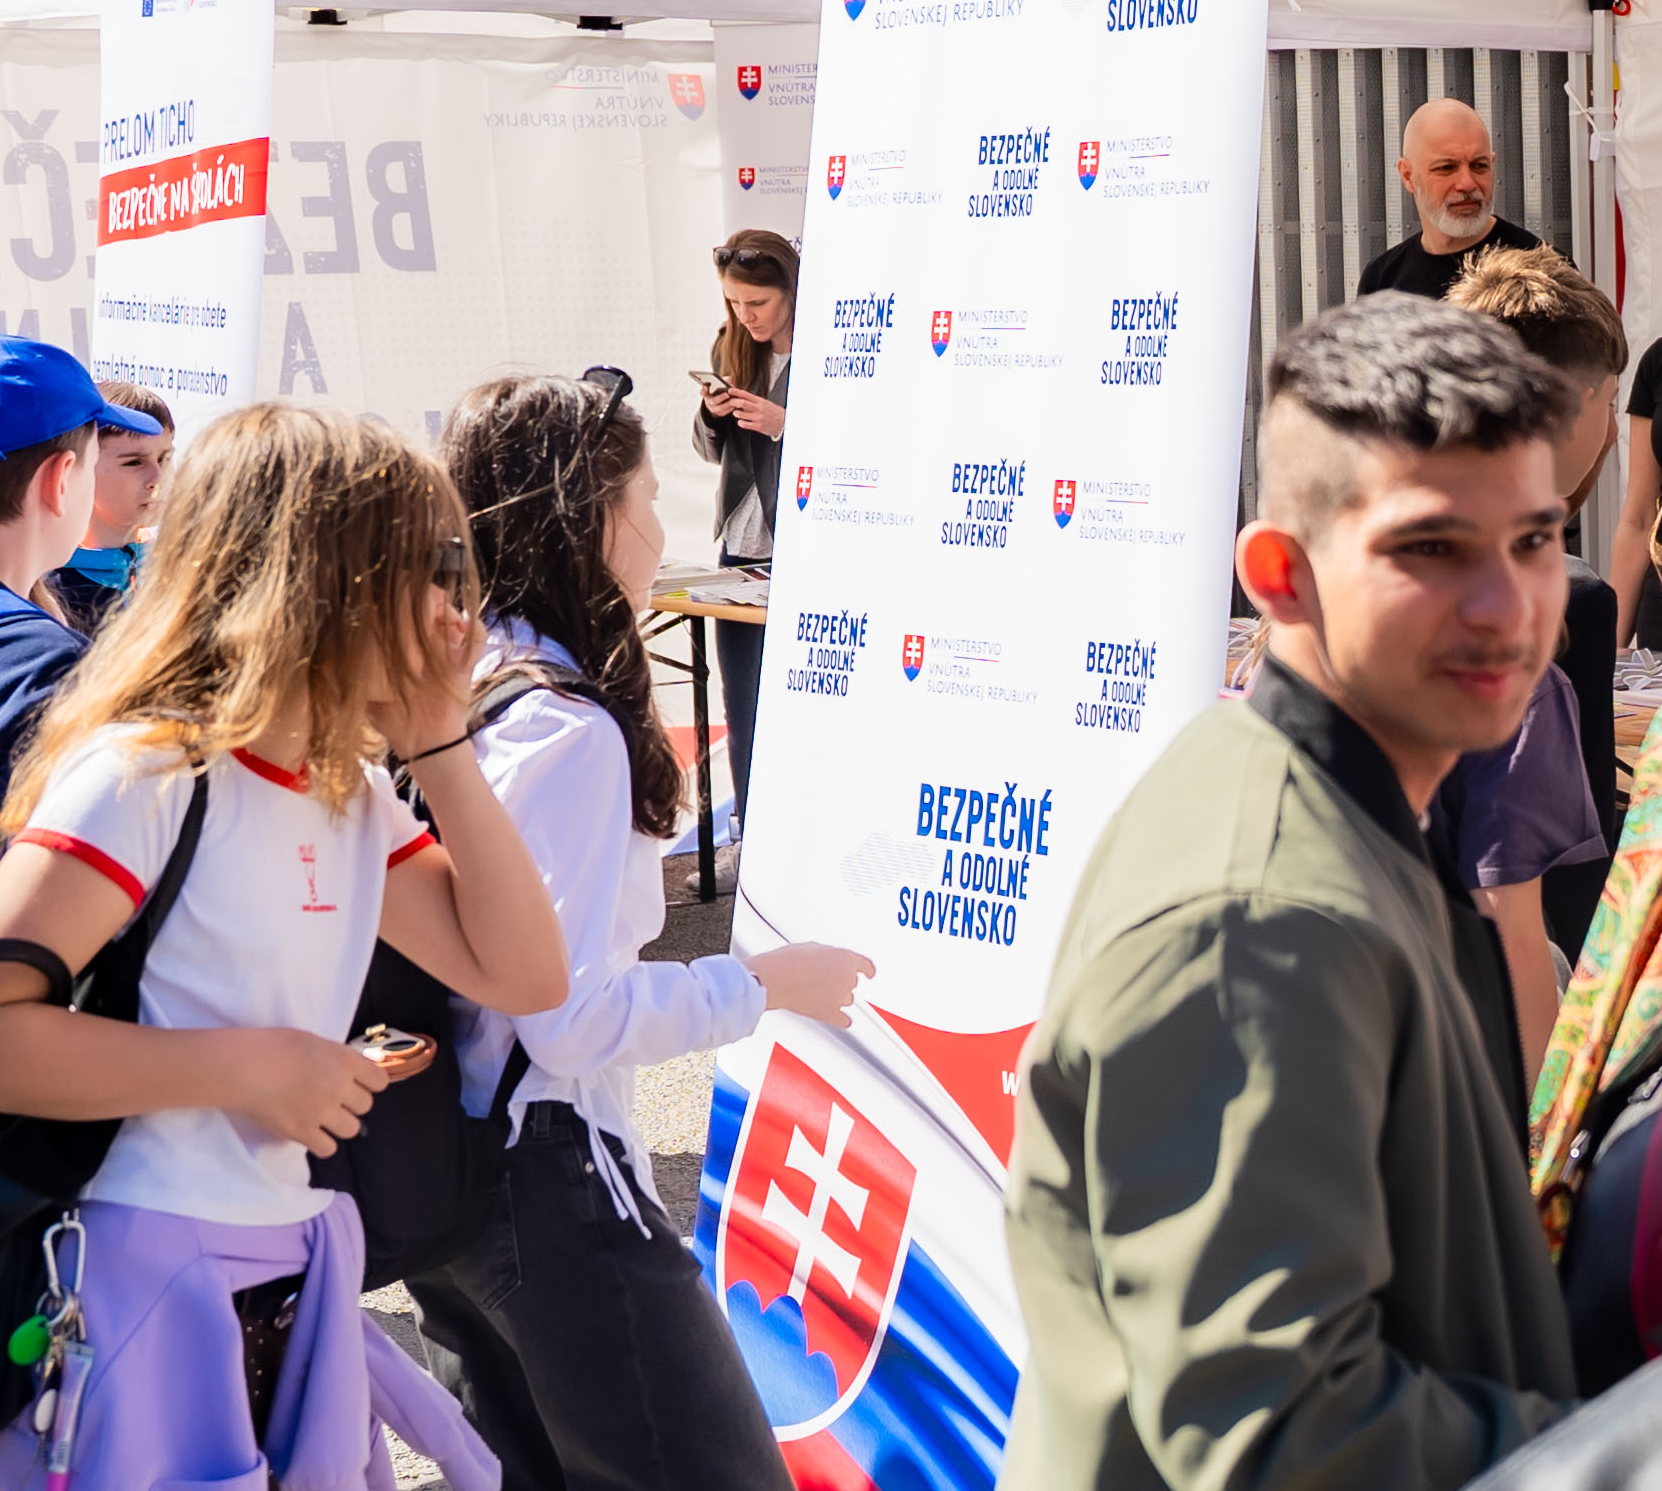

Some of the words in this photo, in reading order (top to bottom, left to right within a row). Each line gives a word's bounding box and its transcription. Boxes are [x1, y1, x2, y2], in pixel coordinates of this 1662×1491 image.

[875, 5, 948, 30] SLOVENSKEJ
[768, 63, 818, 75] MINISTER
[768, 81, 816, 94] VNÚTRA
[768, 94, 815, 106] SLOVENS
[103, 109, 156, 166] PRELOM
[159, 99, 195, 148] TICHO
[978, 125, 1052, 165] BEZPEČNÉ
[992, 169, 1000, 191] A
[1002, 157, 1041, 191] ODOLNÉ
[170, 176, 189, 222] NA
[967, 186, 1034, 218] SLOVENSKO
[833, 291, 895, 330] BEZPEČNÉ
[957, 309, 1029, 325] MINISTERSTVO
[1110, 289, 1179, 331] BEZPEČNÉ
[841, 332, 849, 353] A
[851, 321, 883, 354] ODOLNÉ
[1124, 335, 1132, 358] A
[1134, 322, 1169, 359] ODOLNÉ
[823, 355, 876, 379] SLOVENSKO
[954, 350, 1014, 369] SLOVENSKEJ
[1016, 352, 1064, 369] REPUBLIKY
[1100, 358, 1163, 387] SLOVENSKO
[951, 458, 1027, 497] BEZPEČNÉ
[965, 498, 973, 520] A
[975, 491, 1015, 523] ODOLNÉ
[941, 522, 1008, 549] SLOVENSKO
[796, 609, 868, 648] BEZPEČNÉ
[806, 646, 815, 668] A
[816, 639, 856, 673] ODOLNÉ
[1085, 639, 1157, 680] BEZPEČNÉ
[786, 668, 849, 698] SLOVENSKO
[1100, 679, 1109, 702] A
[1110, 674, 1147, 709] ODOLNÉ
[1074, 702, 1142, 734] SLOVENSKO
[915, 781, 1054, 857] BEZPEČNÉ
[940, 849, 954, 888] A
[958, 848, 1031, 901] ODOLNÉ
[896, 884, 1018, 948] SLOVENSKO
